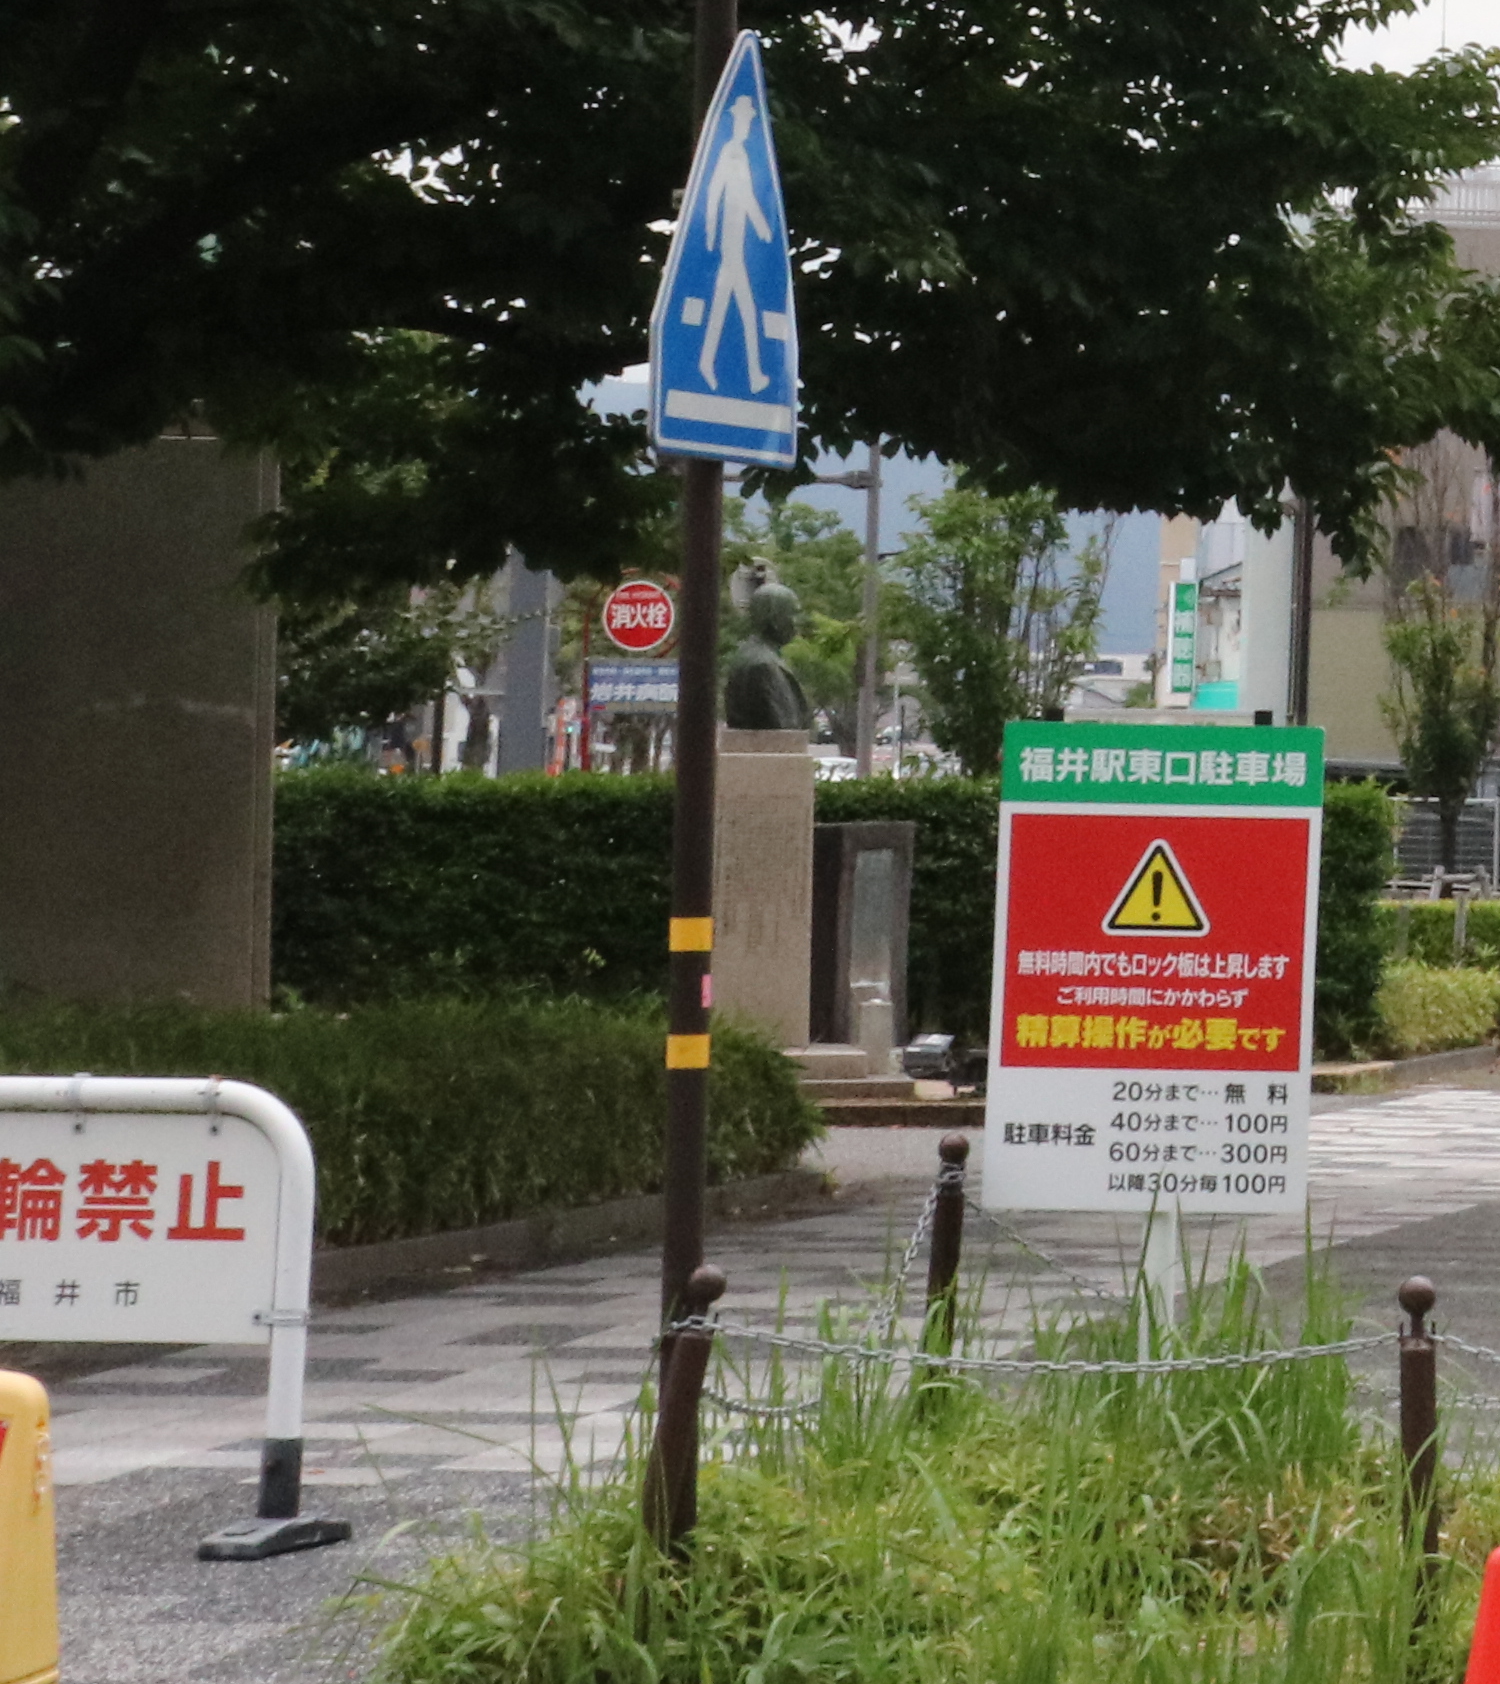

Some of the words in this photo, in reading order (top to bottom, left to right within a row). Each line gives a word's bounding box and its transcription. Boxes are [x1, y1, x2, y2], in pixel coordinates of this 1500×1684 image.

[610, 602, 668, 629] 消火栓
[1018, 746, 1308, 787] 福井駅東口駐車場
[1016, 949, 1291, 980] 無料時間内でもロック板は上昇します
[1055, 985, 1250, 1009] ご利用時間にかかわらず
[1015, 1014, 1287, 1053] 精算操作が必要です
[1003, 1122, 1097, 1147] 駐車料金
[0, 1157, 246, 1242] 輪禁止
[0, 1278, 140, 1307] 福井市
